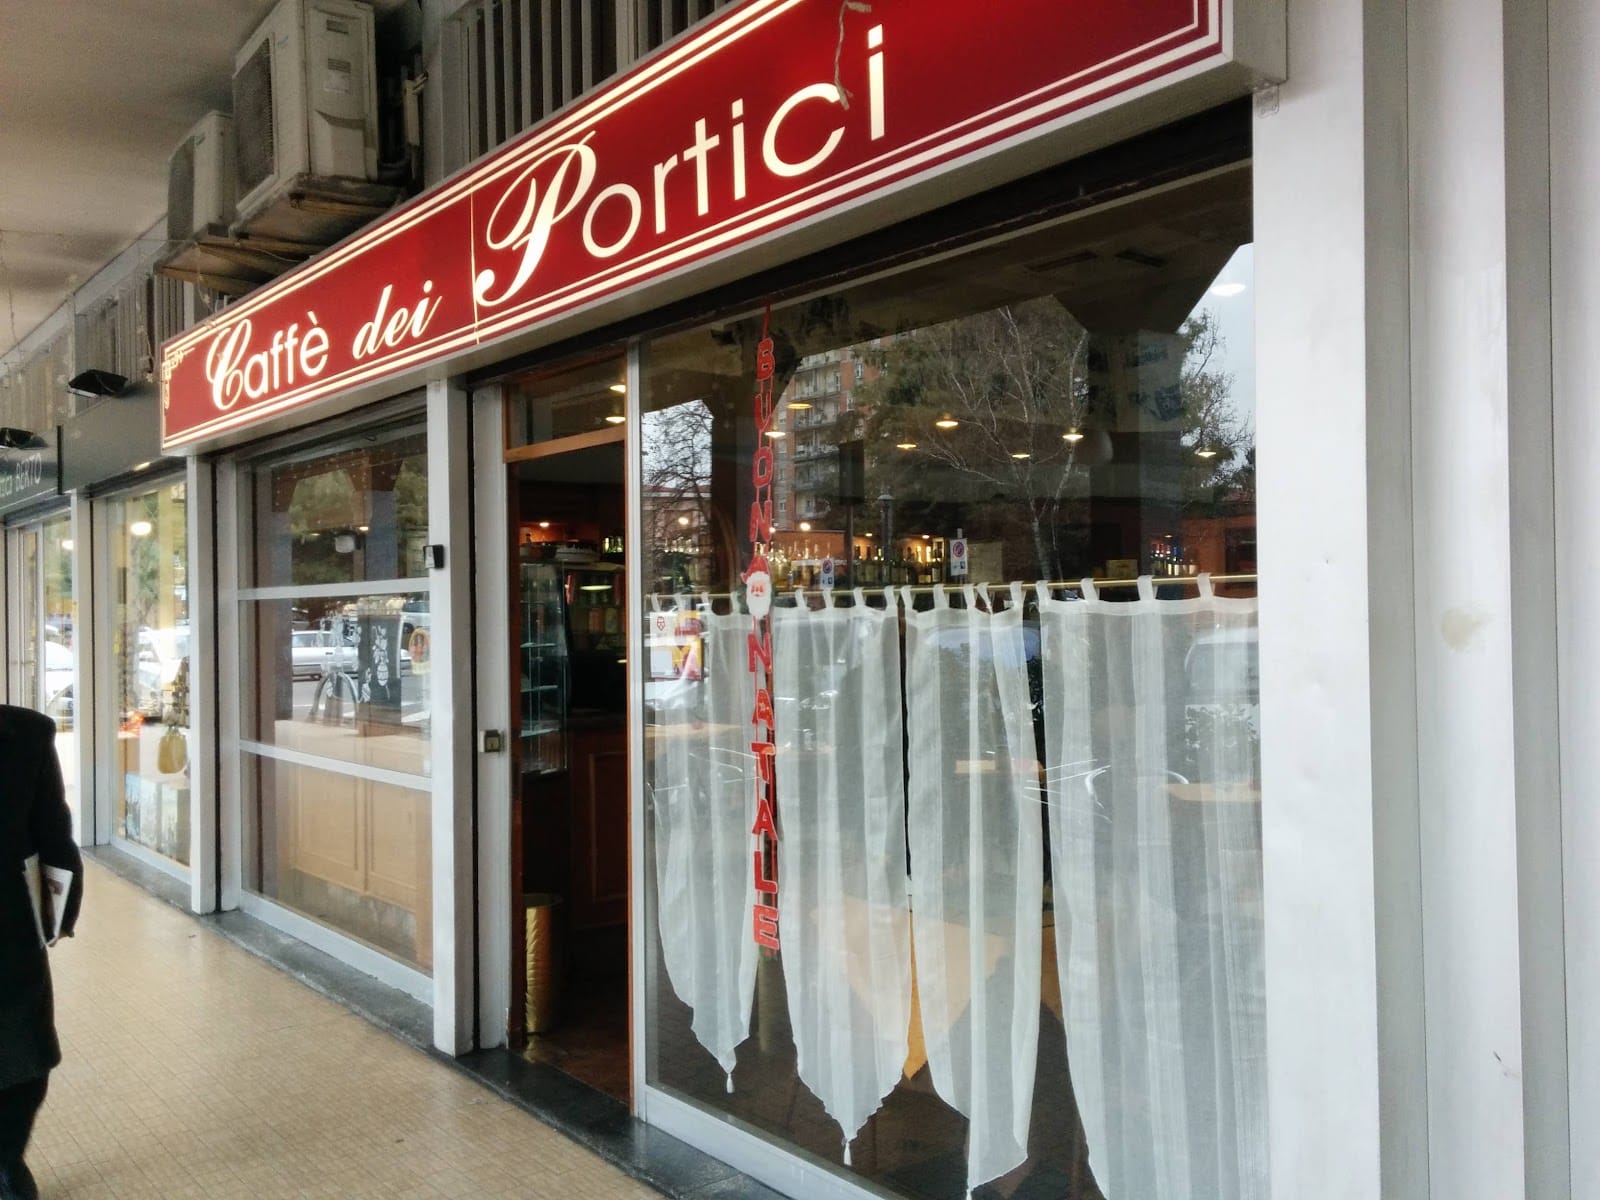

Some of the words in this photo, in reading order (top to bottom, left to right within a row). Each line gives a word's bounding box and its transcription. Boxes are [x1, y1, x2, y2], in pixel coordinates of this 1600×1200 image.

[206, 311, 330, 411] Caffè
[353, 279, 442, 359] dei
[476, 24, 885, 308] Portici
[749, 337, 774, 543] BUON
[747, 631, 780, 951] NATALE
